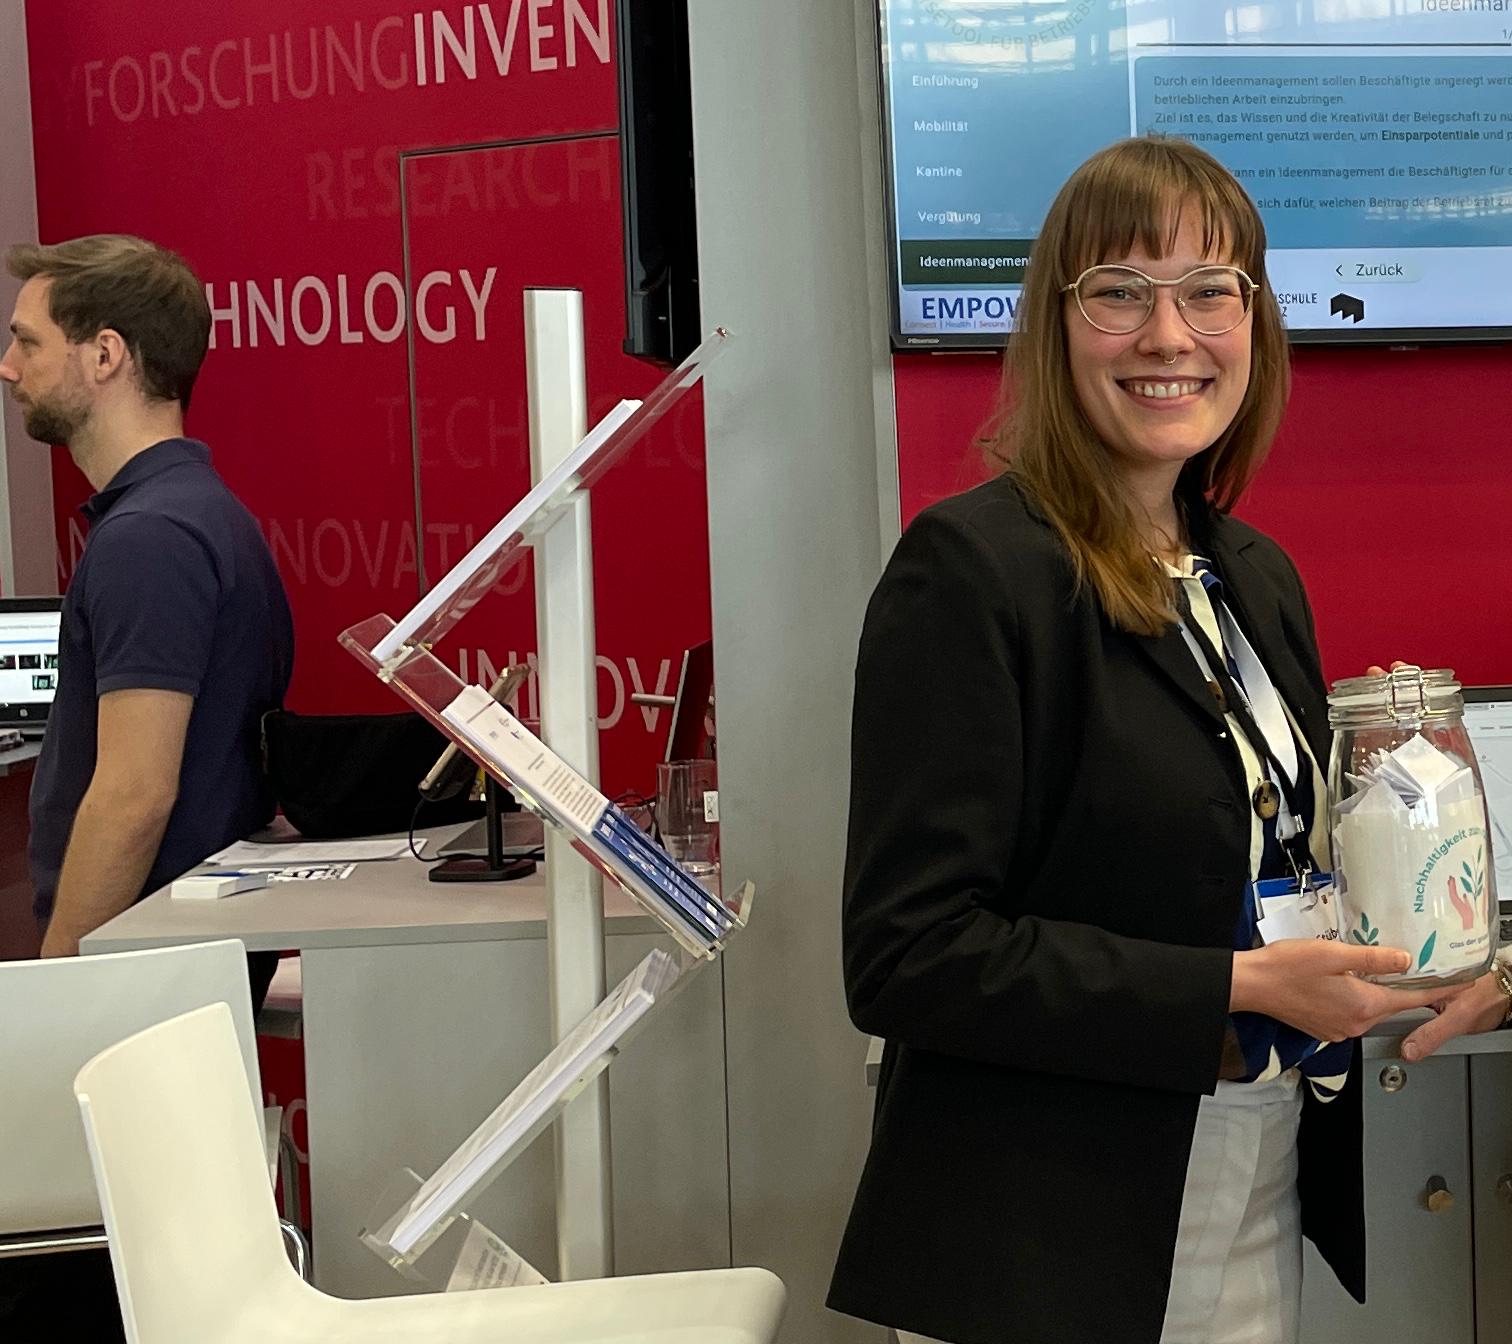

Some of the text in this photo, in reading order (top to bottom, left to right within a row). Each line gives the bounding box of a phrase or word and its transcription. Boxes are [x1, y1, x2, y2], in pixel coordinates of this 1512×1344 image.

[912, 75, 979, 89] Einführung
[1154, 76, 1187, 86] Durch
[1191, 76, 1208, 86] ein
[1211, 76, 1319, 89] Ideenmanagement
[1322, 76, 1356, 86] sollen
[1359, 75, 1431, 88] Beschäftigte
[1434, 76, 1484, 88] angeregt
[1154, 94, 1229, 105] betrieblichen
[1232, 94, 1267, 105] Arbeit
[1155, 112, 1176, 123] Ziel
[1179, 113, 1194, 123] ist
[1216, 113, 1238, 123] das
[1240, 112, 1283, 123] Wissen
[1285, 112, 1307, 123] und
[1309, 112, 1328, 123] die
[1331, 111, 1389, 123] Kreativität
[1392, 111, 1411, 123] der
[1413, 111, 1481, 124] Belegschaft
[1483, 113, 1497, 122] zu
[914, 121, 969, 133] Mobilität
[1266, 131, 1309, 143] genutzt
[1359, 132, 1379, 141] um
[1381, 129, 1480, 143] Einsparpotentiale
[1483, 129, 1504, 140] und
[916, 166, 963, 177] Kantine
[1258, 167, 1276, 178] ein
[1279, 167, 1386, 180] Ideenmanagement
[1388, 166, 1405, 177] die
[1408, 165, 1487, 178] Beschäftigten
[1489, 165, 1505, 177] für
[1257, 197, 1281, 208] sich
[1318, 197, 1366, 208] welchen
[1369, 197, 1409, 209] Beitrag
[1355, 263, 1404, 277] Zurück
[1278, 292, 1318, 305] SCHULE
[1413, 829, 1468, 913] Nachhaltigkeit
